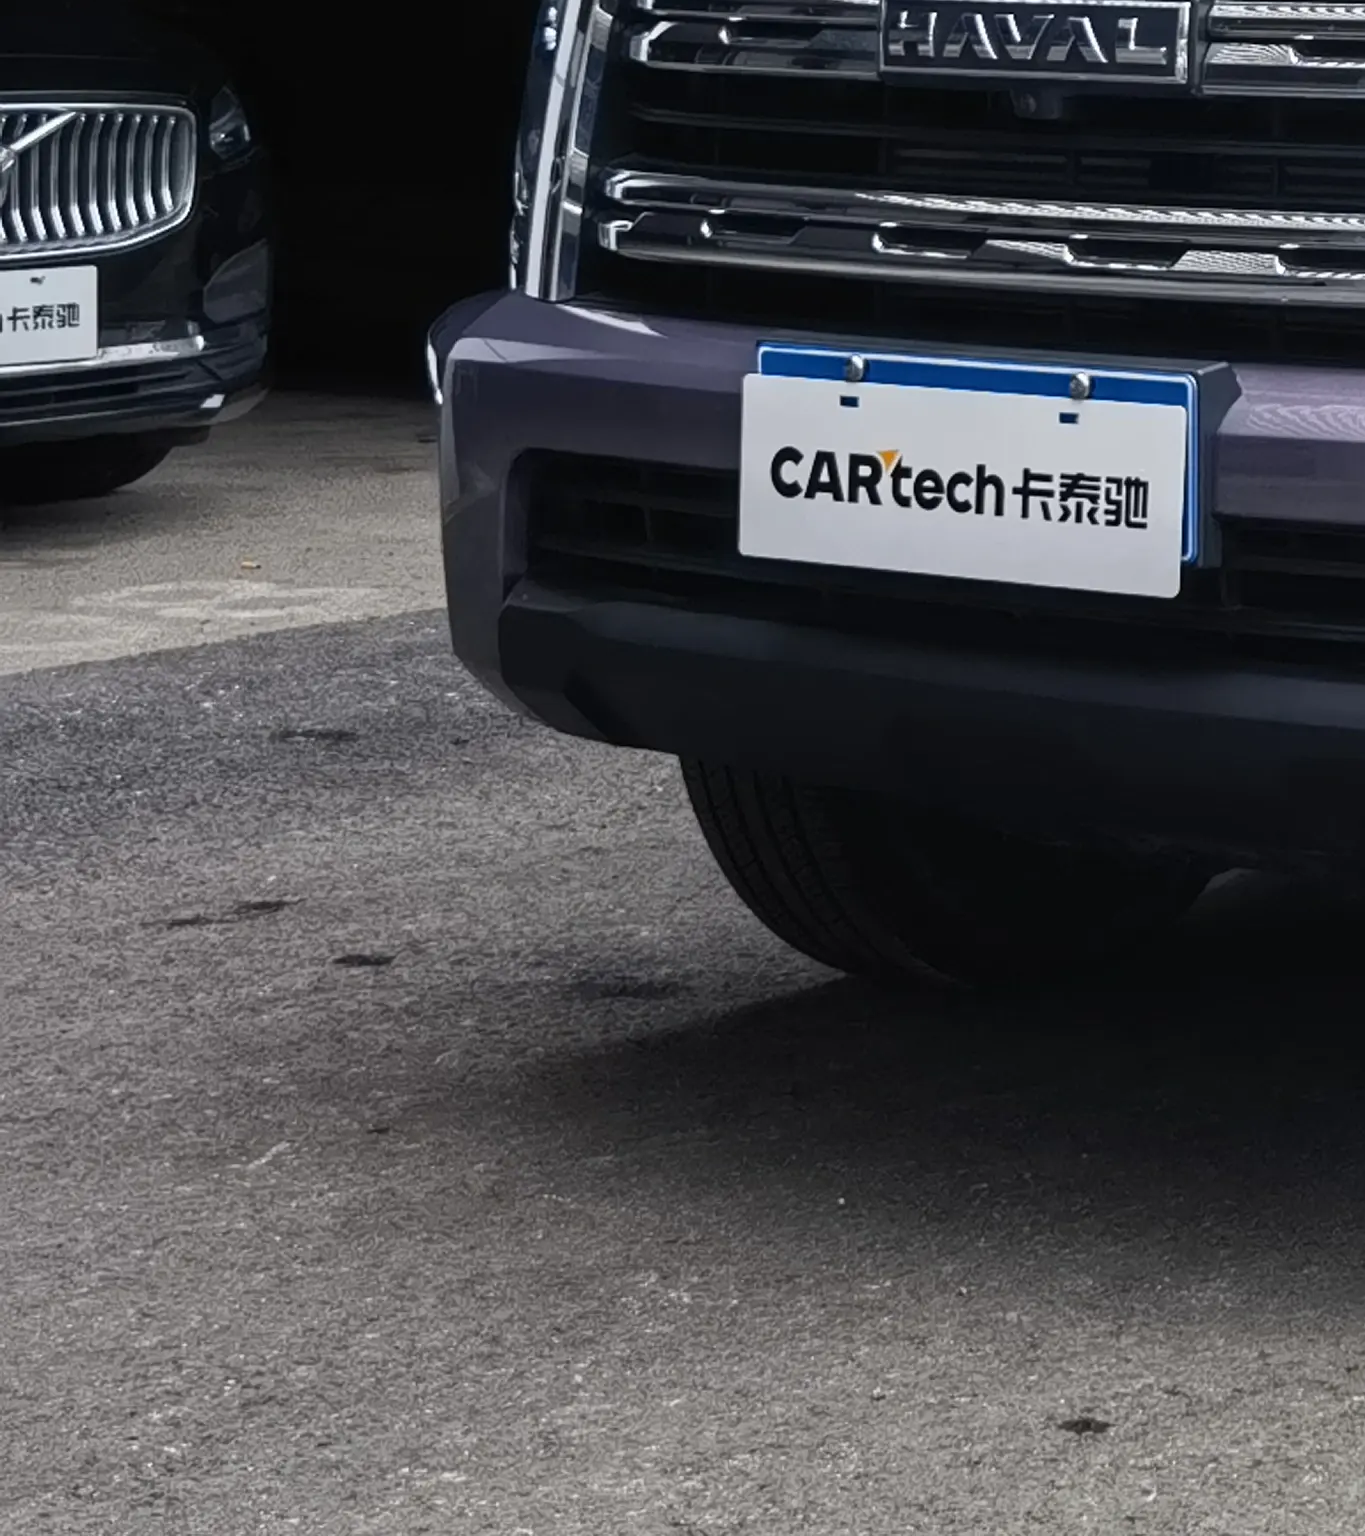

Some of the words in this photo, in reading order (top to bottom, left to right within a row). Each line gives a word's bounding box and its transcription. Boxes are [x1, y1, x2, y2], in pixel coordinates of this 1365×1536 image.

[889, 11, 1167, 65] HAVAL
[7, 302, 80, 332] 卡泰驰
[770, 445, 1005, 516] CARtech
[1012, 467, 1149, 529] 卡泰驰
